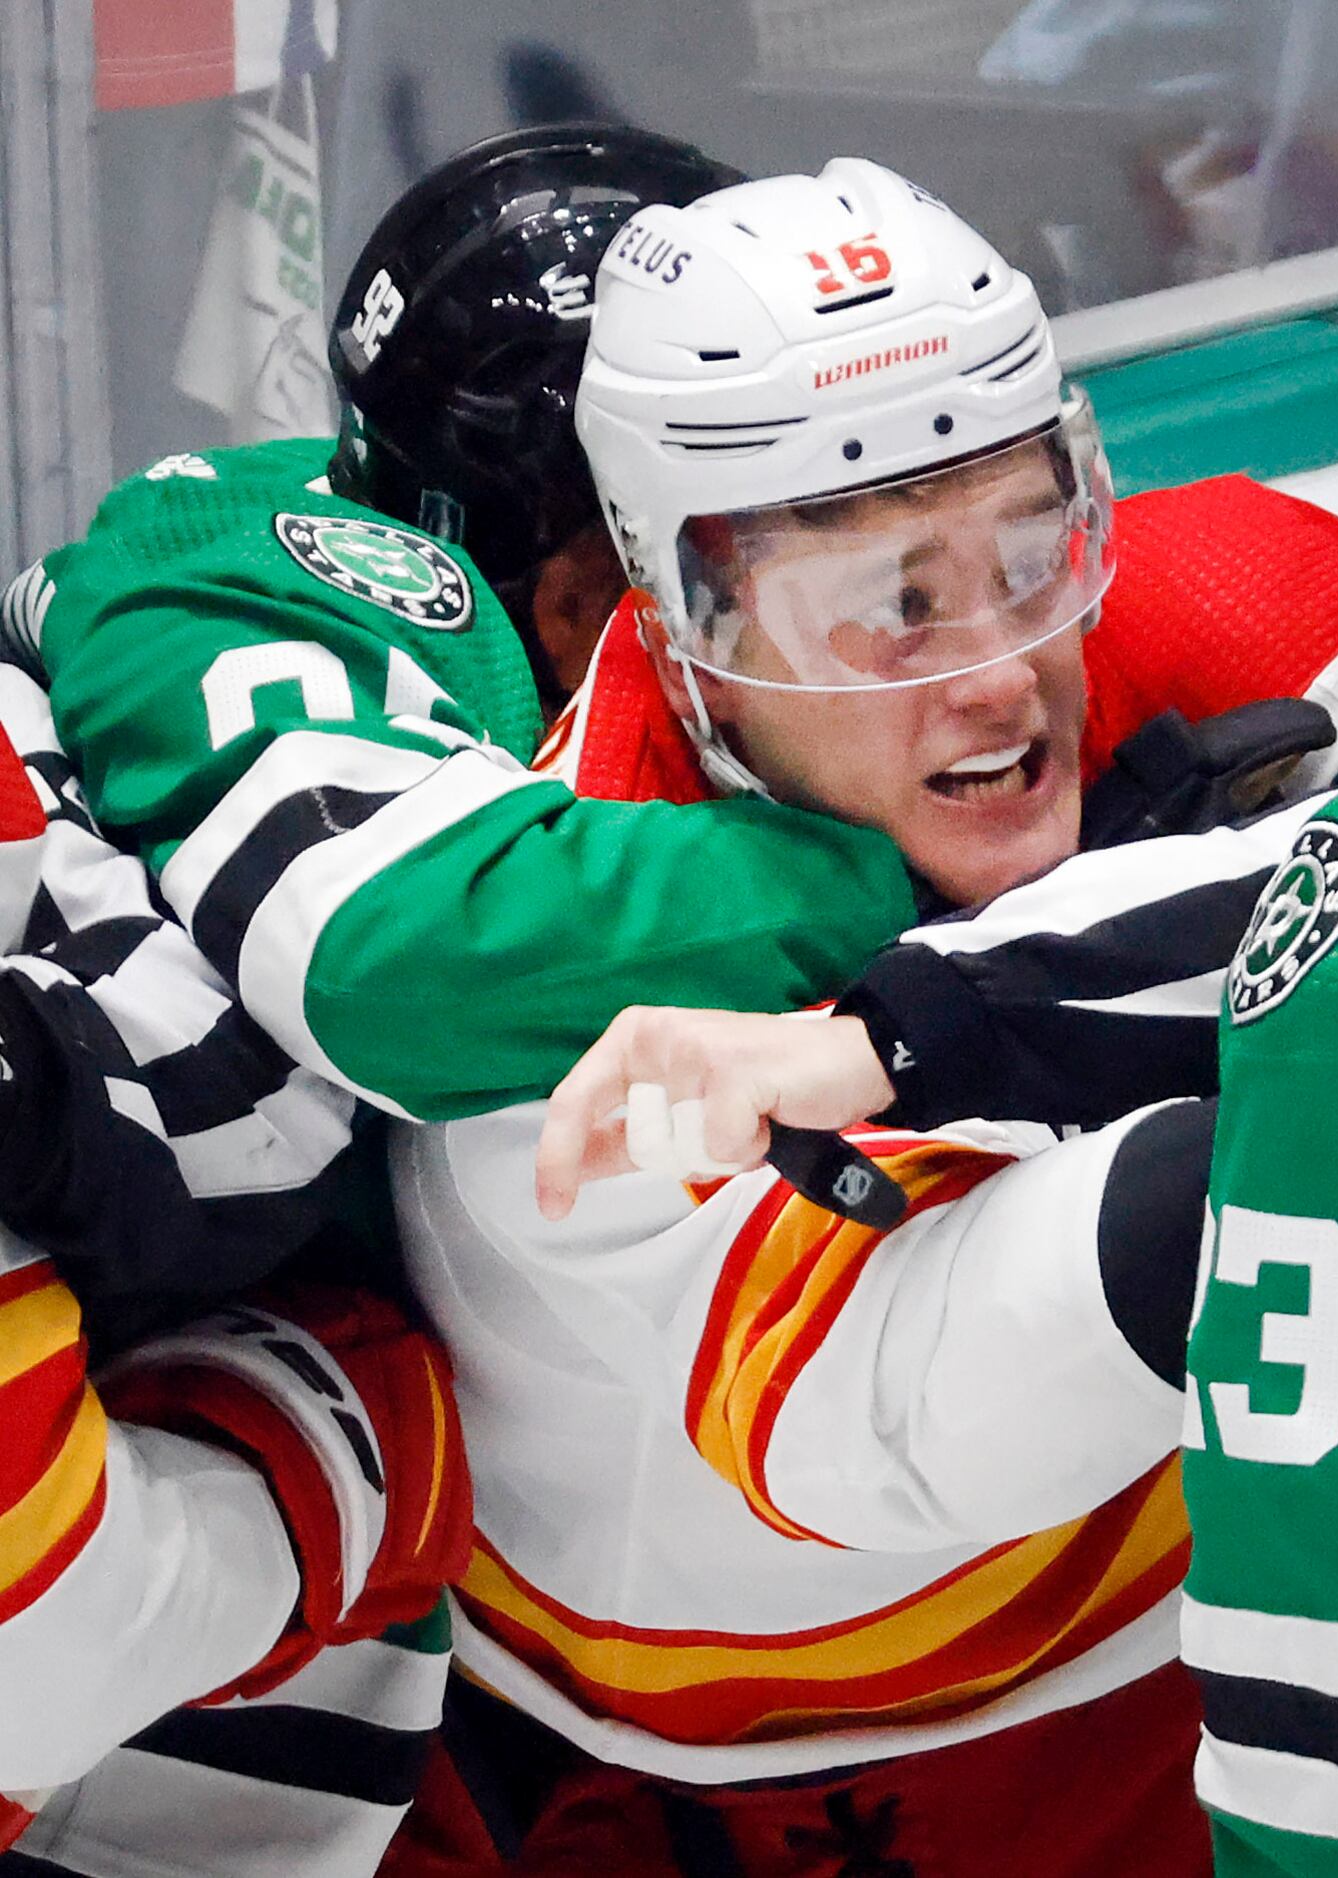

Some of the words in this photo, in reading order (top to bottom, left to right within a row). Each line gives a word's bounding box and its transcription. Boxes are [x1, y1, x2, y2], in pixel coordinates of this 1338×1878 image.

[608, 221, 692, 284] TELUS
[351, 267, 405, 362] 92
[814, 336, 949, 389] WARRIOR
[289, 527, 428, 617] STARS
